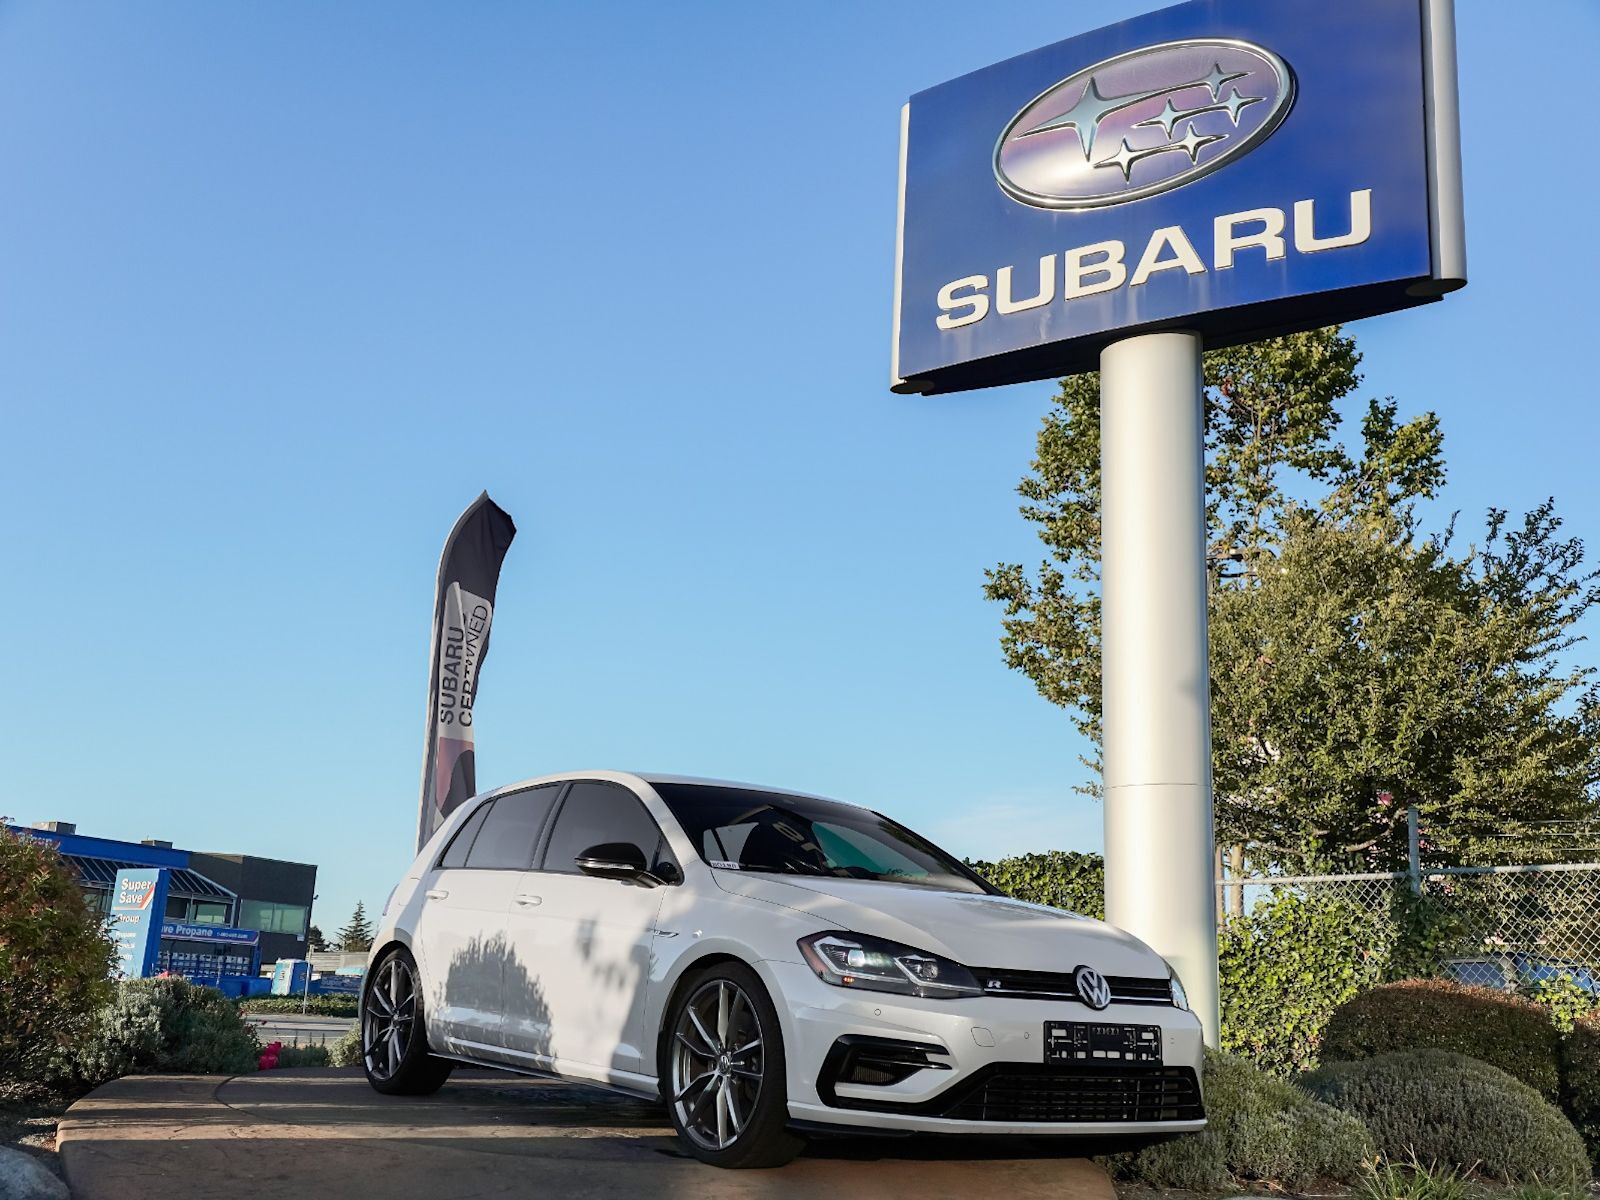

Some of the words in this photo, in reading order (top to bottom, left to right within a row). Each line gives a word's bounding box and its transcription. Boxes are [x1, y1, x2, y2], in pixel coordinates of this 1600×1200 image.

[935, 188, 1372, 331] SUBARU
[440, 626, 465, 726] SUBARU
[121, 878, 151, 892] Super
[119, 892, 143, 904] Save
[176, 925, 213, 937] Propane
